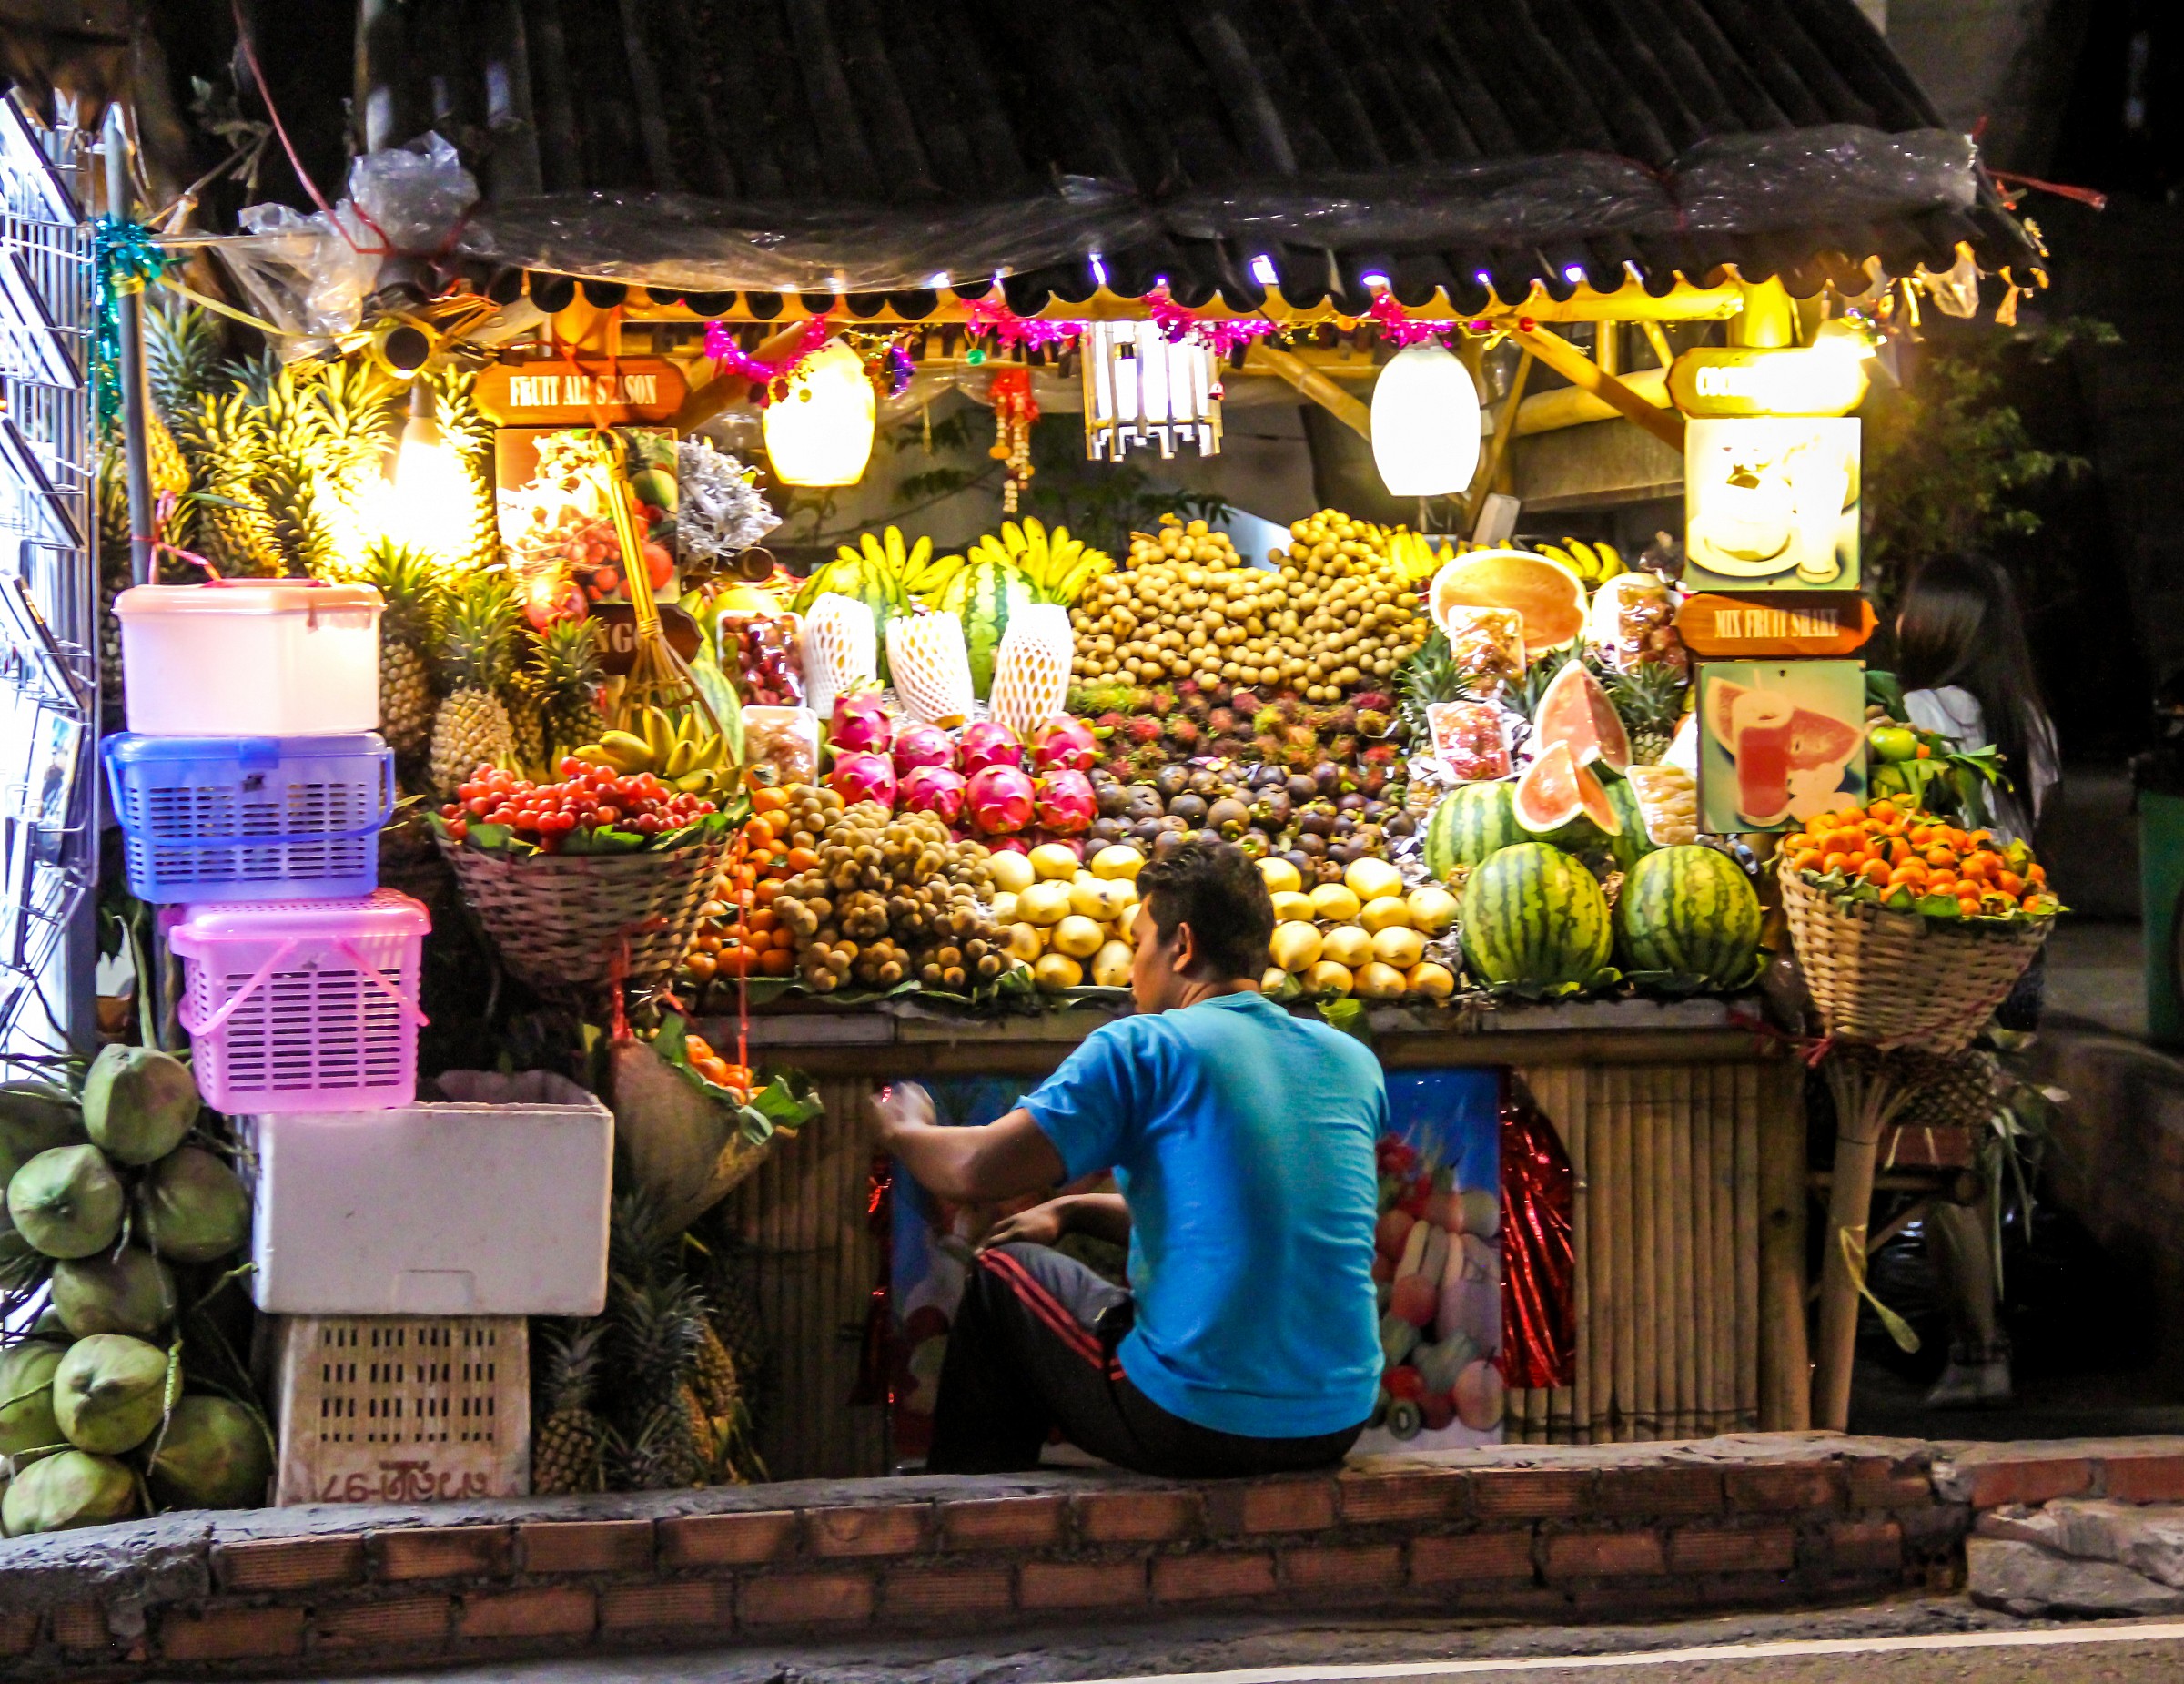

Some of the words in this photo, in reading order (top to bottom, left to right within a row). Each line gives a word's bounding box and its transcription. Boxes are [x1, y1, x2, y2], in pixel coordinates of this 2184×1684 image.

[509, 375, 560, 406] FRUIT
[1714, 609, 1742, 638] MIX
[1745, 609, 1787, 638] FRUIT
[1791, 608, 1839, 637] SHAKE
